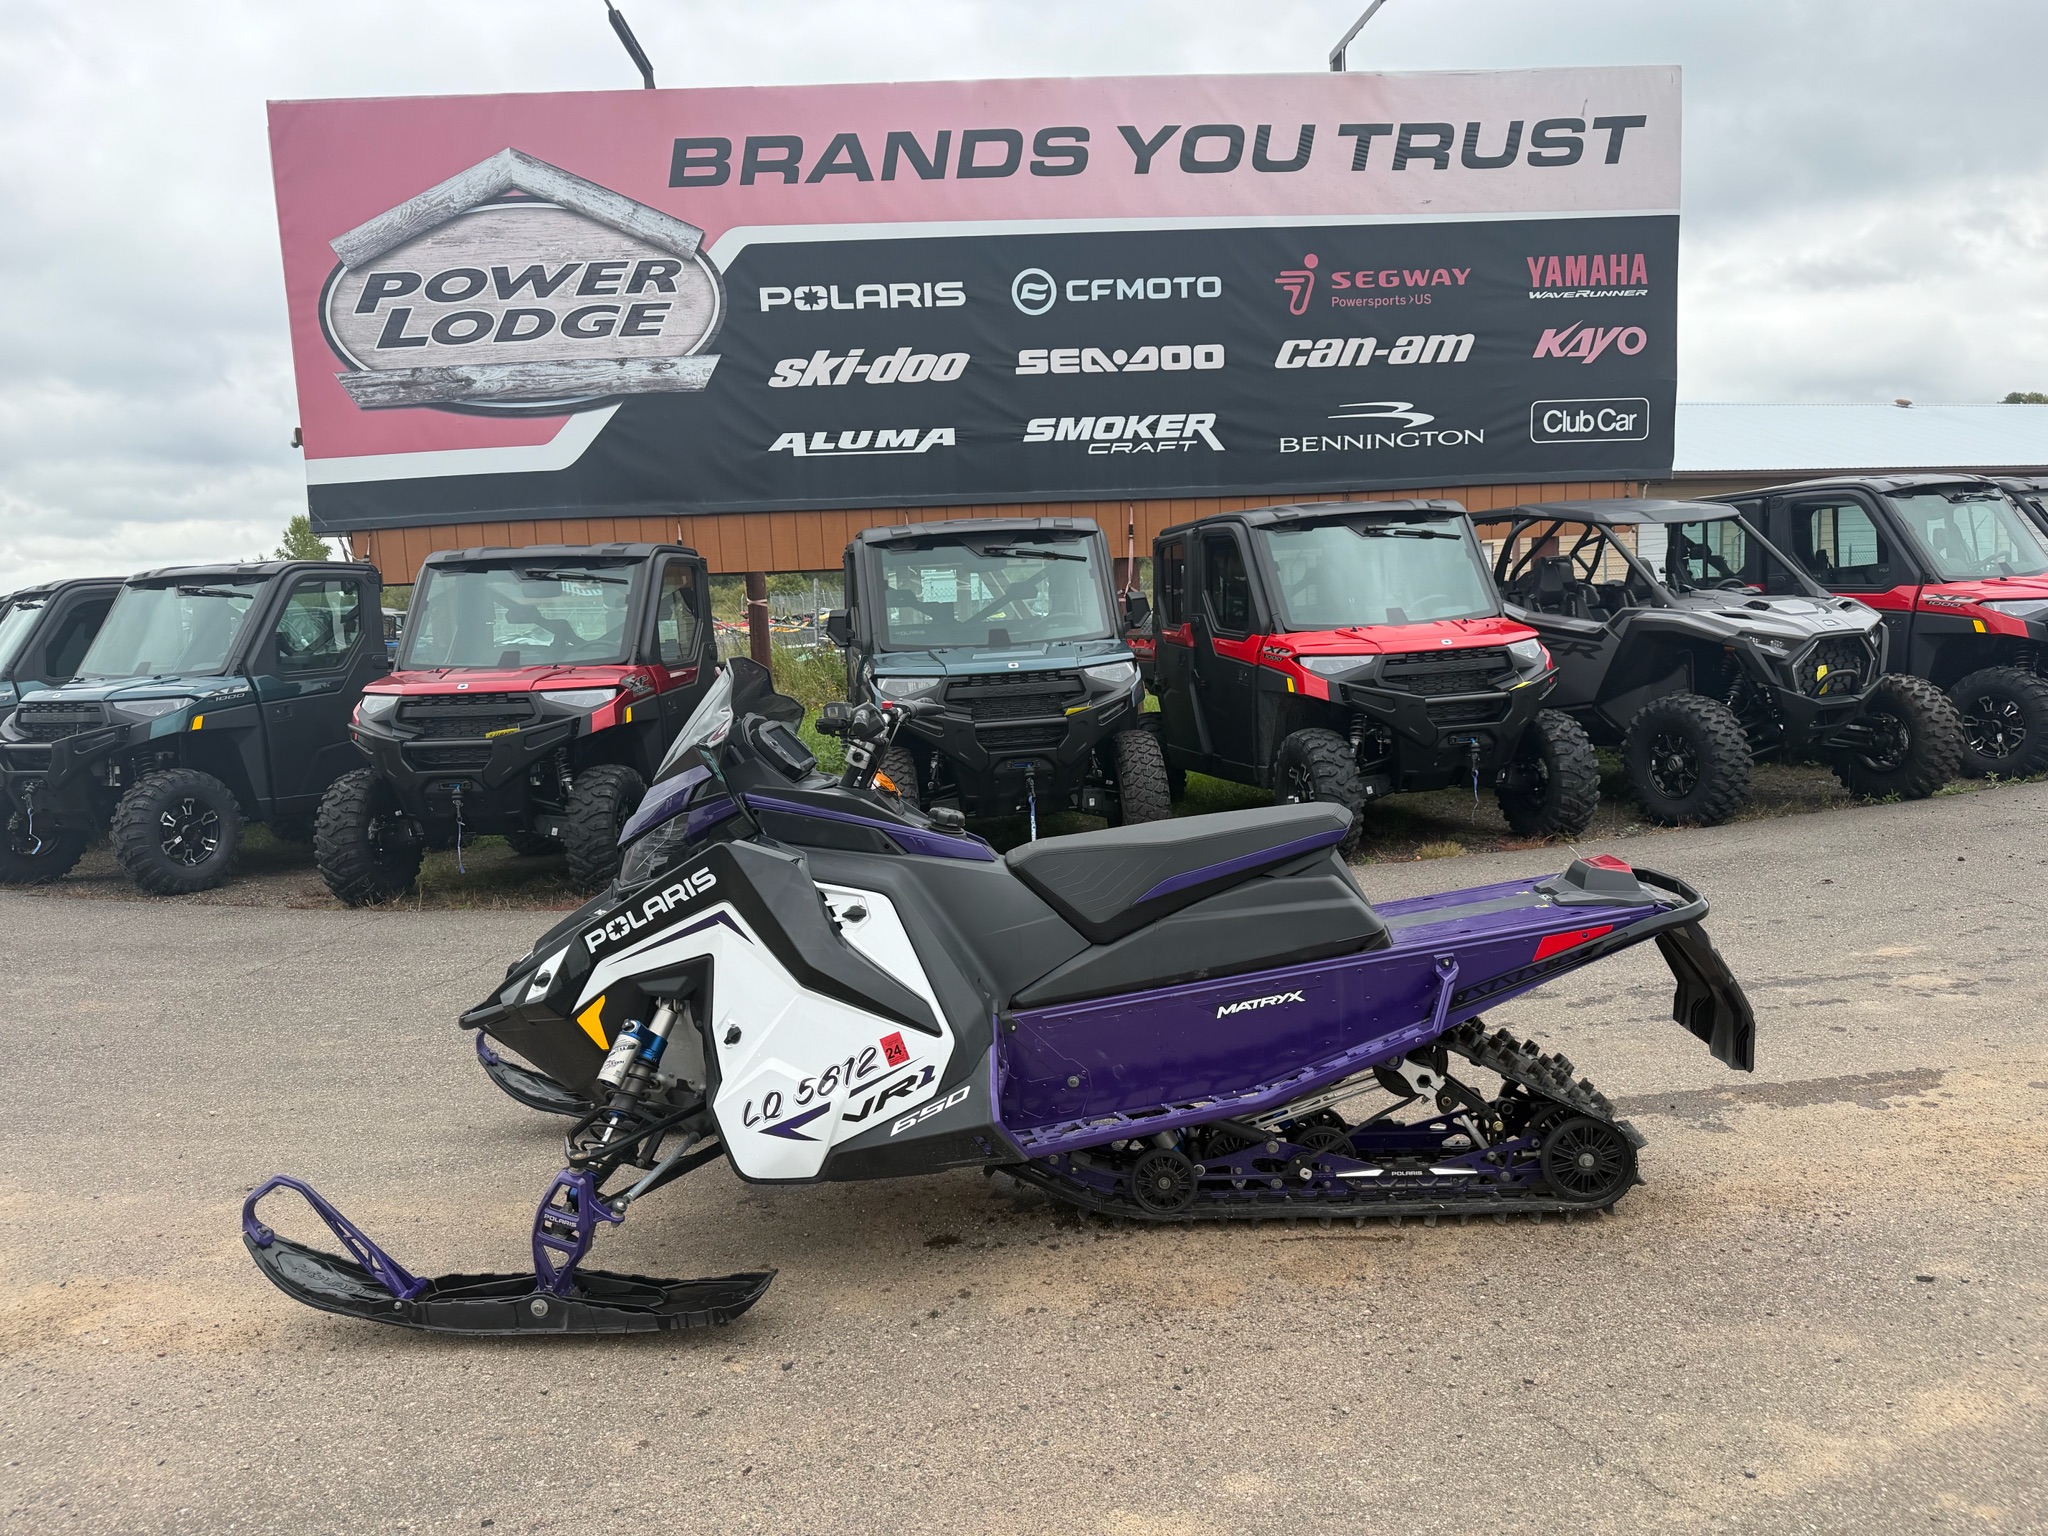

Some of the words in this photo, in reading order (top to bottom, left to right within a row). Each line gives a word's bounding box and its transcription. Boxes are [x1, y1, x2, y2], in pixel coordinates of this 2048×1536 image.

[668, 126, 1091, 189] BRANDS
[1116, 123, 1317, 175] YOU
[1337, 114, 1648, 172] TRUST
[1331, 267, 1472, 289] SEGWAY
[1526, 253, 1649, 288] YAMAHA
[354, 258, 683, 315] POWER
[759, 281, 967, 312] POLARIS
[1065, 275, 1222, 302] CFMOTO
[374, 302, 673, 351] LODGE
[1532, 320, 1648, 364] KAYO
[1274, 333, 1476, 369] can-am
[767, 346, 971, 389] ski-doo
[1023, 413, 1226, 451] SMOKER
[1543, 409, 1595, 434] Club
[1596, 408, 1638, 434] Car
[767, 427, 957, 457] ALUMA
[1087, 440, 1198, 455] CRAFT
[1279, 428, 1485, 453] BENNINGTON
[1265, 645, 1291, 655] XP
[215, 693, 246, 701] 1000
[584, 866, 717, 954] POLARIS
[1216, 989, 1306, 1019] MATRYX
[885, 1044, 903, 1060] 24
[889, 1085, 971, 1137] 650
